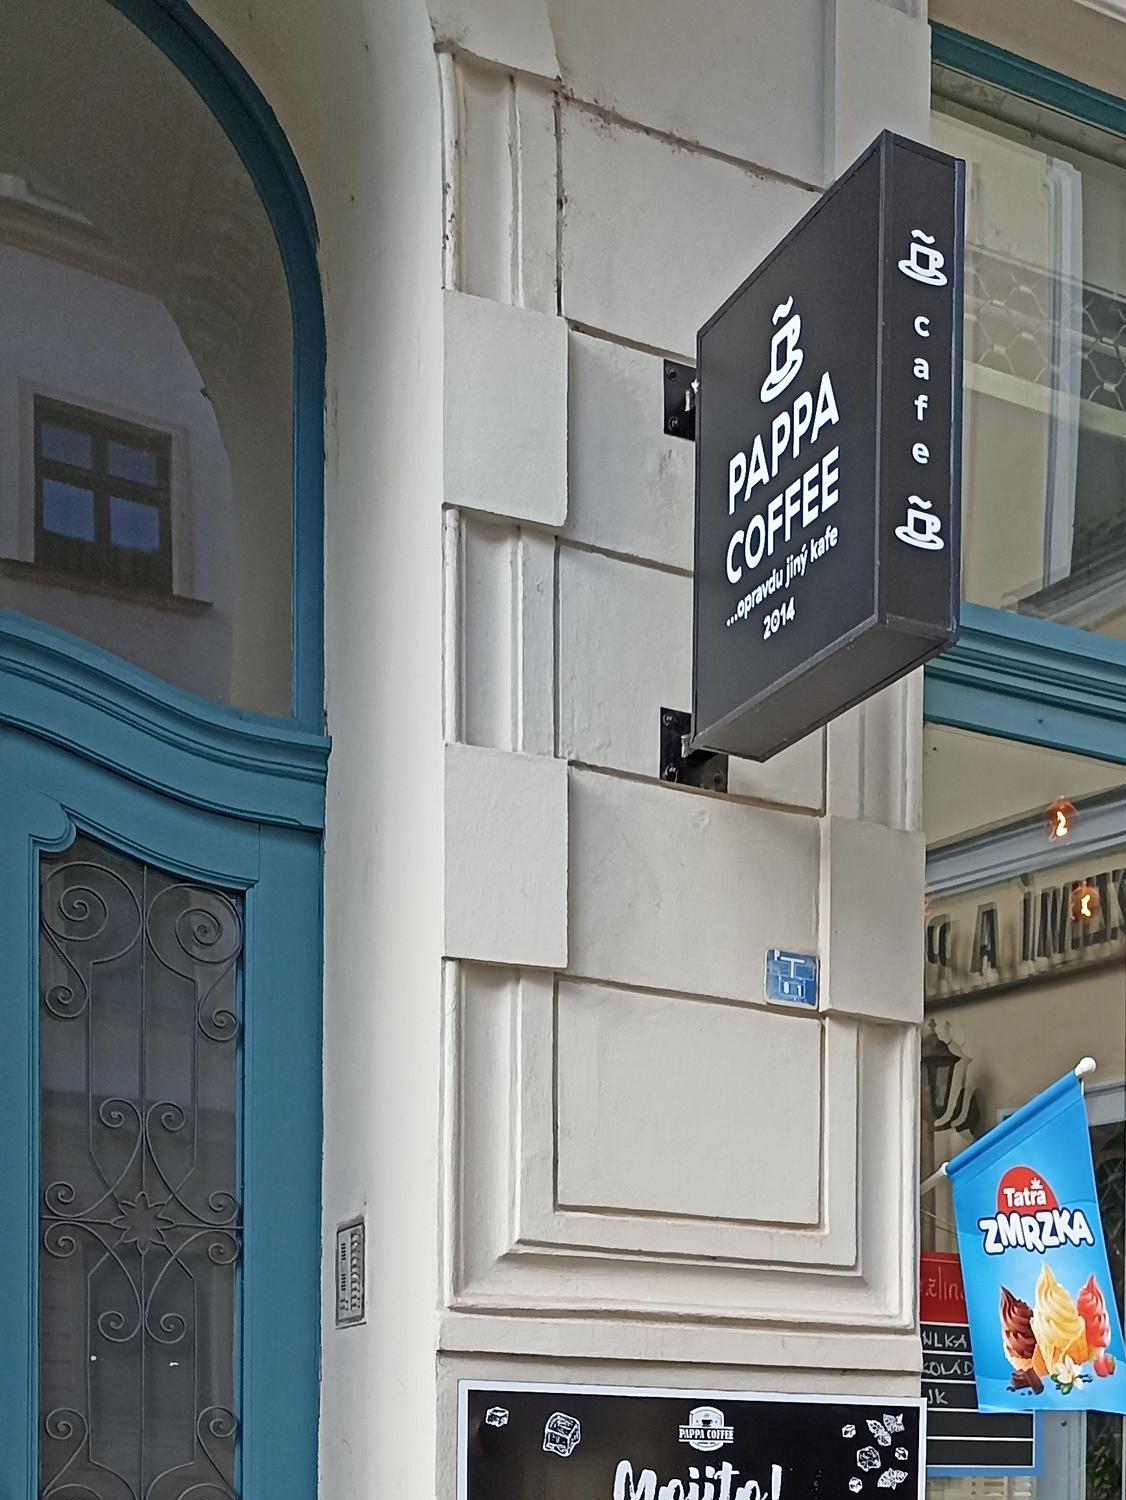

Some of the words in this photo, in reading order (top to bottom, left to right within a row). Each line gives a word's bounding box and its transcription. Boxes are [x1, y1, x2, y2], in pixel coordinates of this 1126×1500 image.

[728, 371, 840, 516] PAPPA
[726, 446, 841, 585] COFFEE
[726, 567, 784, 627] ...opravdu
[785, 544, 808, 587] jiný
[809, 526, 839, 565] kafe
[762, 596, 796, 640] 2014
[1003, 1186, 1047, 1208] Tatra
[978, 1208, 1095, 1254] ZMRZKA
[679, 1428, 705, 1439] PAPPA
[706, 1429, 734, 1440] COFFEE
